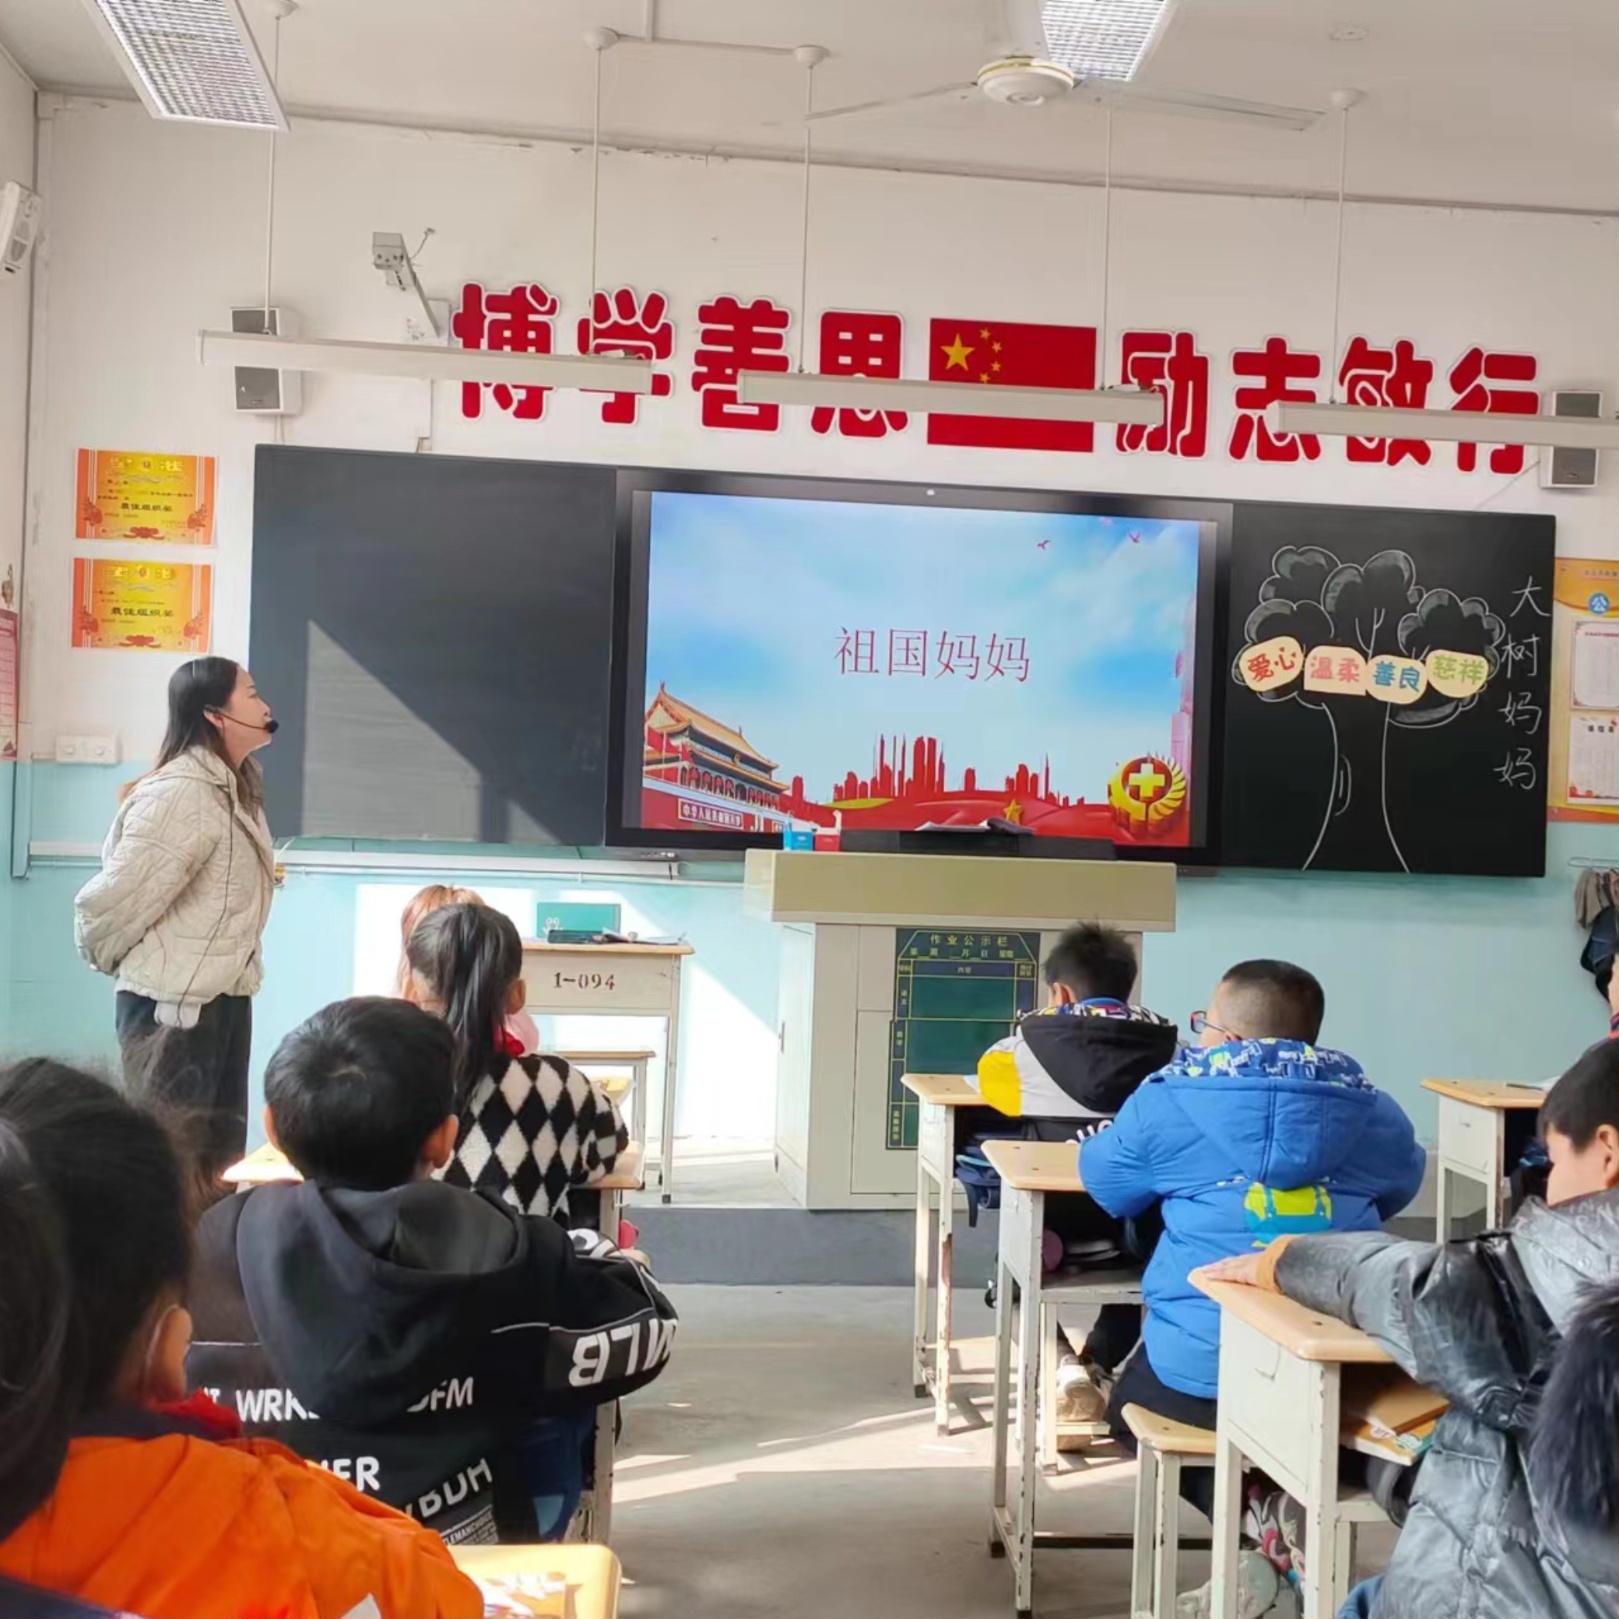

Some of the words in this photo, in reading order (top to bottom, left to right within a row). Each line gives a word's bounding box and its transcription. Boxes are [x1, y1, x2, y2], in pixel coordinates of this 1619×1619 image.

[452, 282, 909, 439] 博学善思
[1115, 331, 1540, 475] 励志敏行
[833, 626, 1030, 683] 祖国妈妈
[1246, 646, 1298, 683] 爱心
[1309, 655, 1361, 684] 温柔
[1432, 654, 1486, 686] 慈祥
[1372, 660, 1421, 693] 善良
[1493, 575, 1552, 790] 大树妈妈
[930, 933, 1008, 948] 作业公示栏
[553, 972, 616, 991] 1-094
